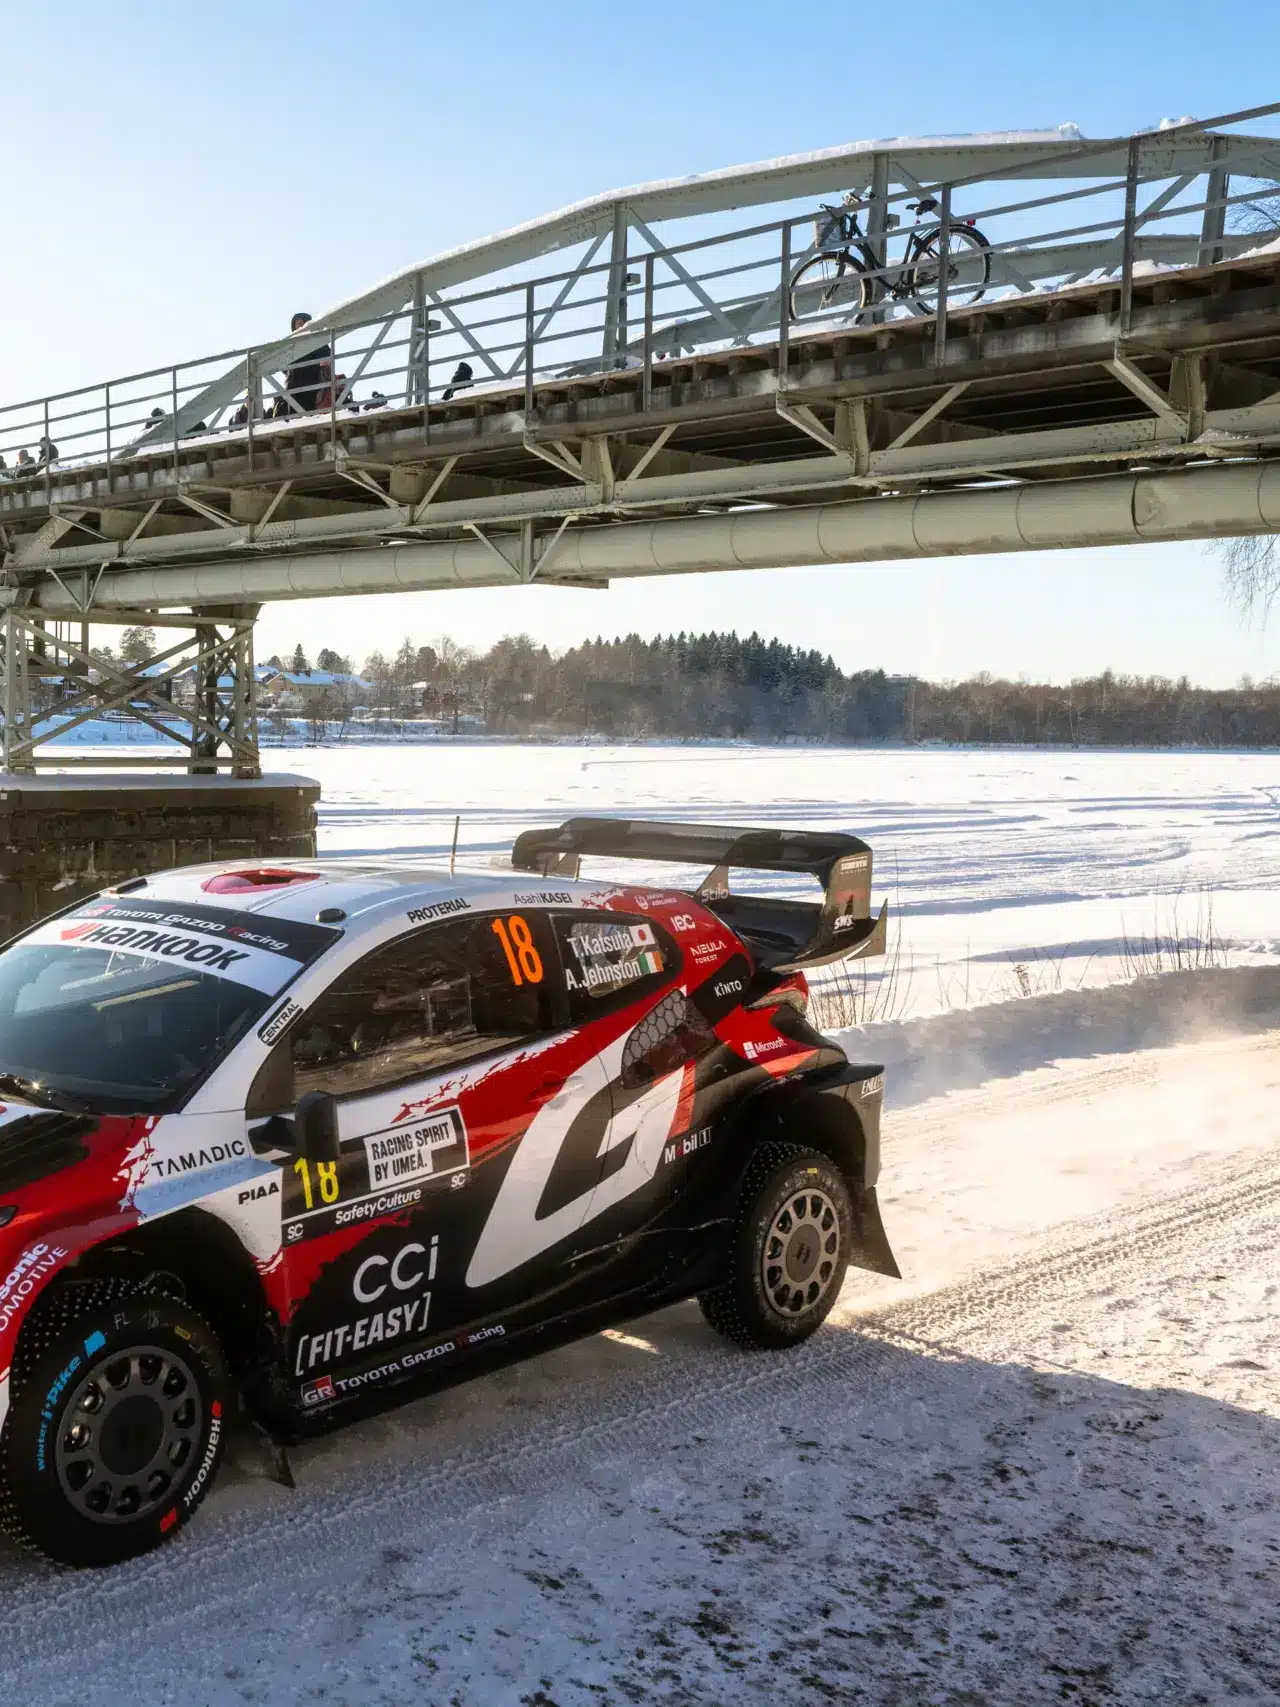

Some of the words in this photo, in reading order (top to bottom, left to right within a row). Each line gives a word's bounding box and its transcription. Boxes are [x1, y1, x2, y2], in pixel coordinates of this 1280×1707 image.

[406, 897, 472, 924] PROTERIAL
[106, 909, 164, 921] TOYOTA
[226, 926, 290, 950] Racing
[491, 915, 543, 986] 18
[565, 959, 641, 991] A.Johnston
[260, 1002, 300, 1044] CENTRAL
[754, 1037, 787, 1054] Microsoft
[151, 1140, 245, 1177] TAMADIC
[370, 1136, 413, 1161] RACING
[415, 1122, 451, 1147] SPIRIT
[294, 1157, 340, 1209] 18
[373, 1161, 389, 1183] BY
[451, 1173, 466, 1189] SC
[238, 1181, 280, 1206] PIAA
[335, 1188, 422, 1225] SafetyCulture
[286, 1222, 304, 1240] SC
[303, 1382, 336, 1405] GR
[336, 1361, 400, 1391] TOYOTA
[402, 1341, 455, 1368] GAZOO
